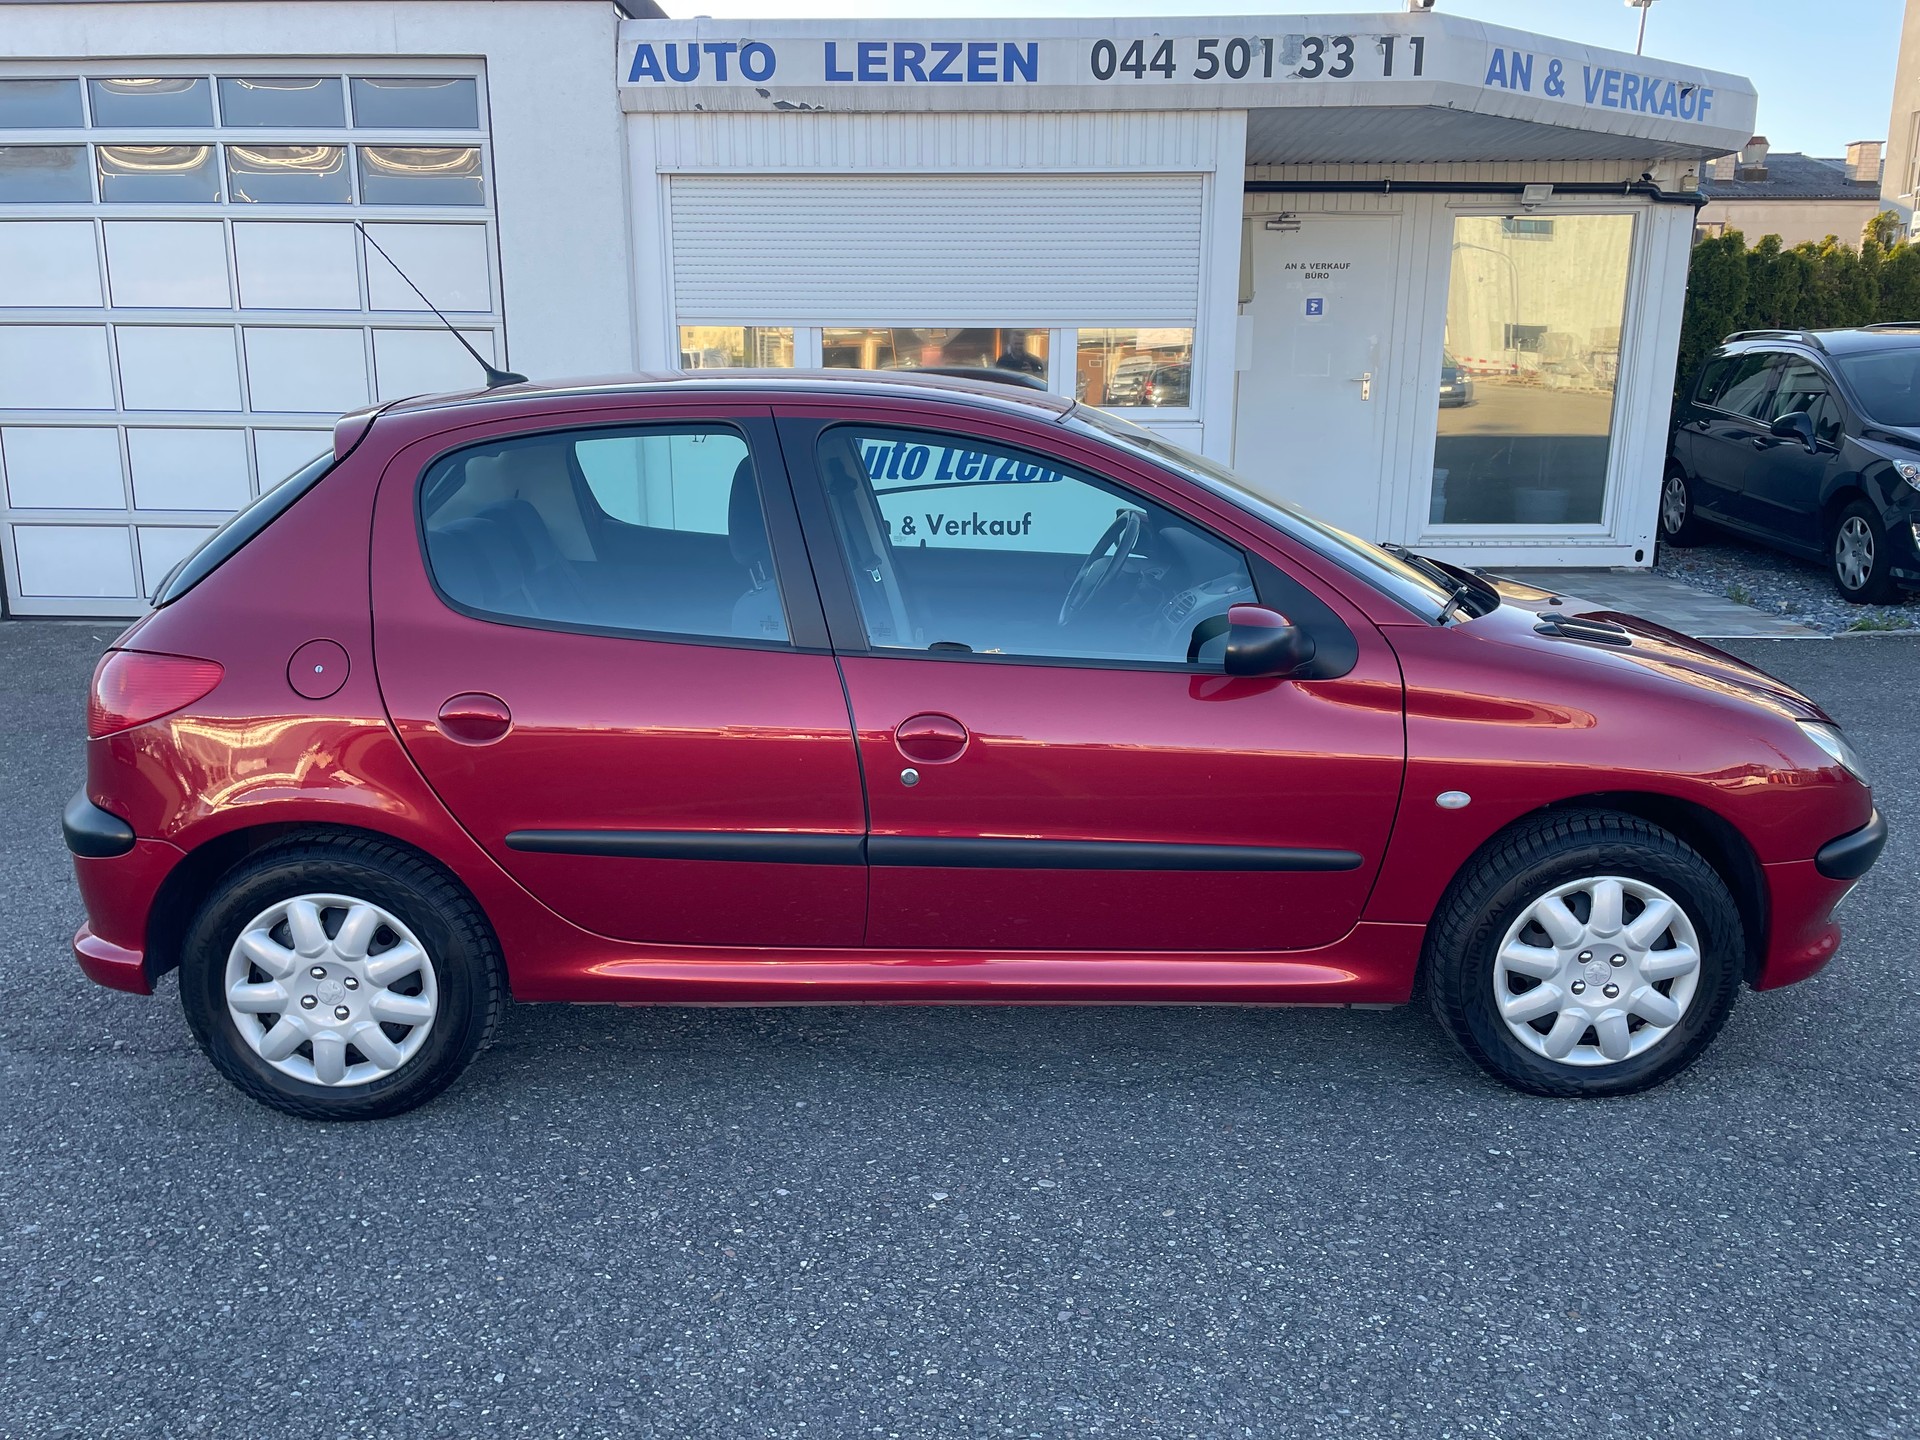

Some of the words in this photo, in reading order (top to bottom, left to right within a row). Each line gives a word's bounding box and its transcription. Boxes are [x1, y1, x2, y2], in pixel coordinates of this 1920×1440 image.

[628, 41, 777, 83] AUTO
[824, 41, 1039, 83] LERZEN
[1090, 38, 1177, 81] 044
[1193, 37, 1274, 80] 501
[1298, 36, 1355, 79] 33
[1379, 36, 1425, 77] 11
[1484, 48, 1534, 92] AN
[1544, 58, 1566, 98] &
[1583, 65, 1714, 122] VERKAUF
[1305, 271, 1329, 279] BÜRO
[856, 439, 931, 481] uto
[901, 515, 917, 536] &
[925, 511, 1032, 536] Verkauf
[1467, 900, 1511, 987] UNIROYAL
